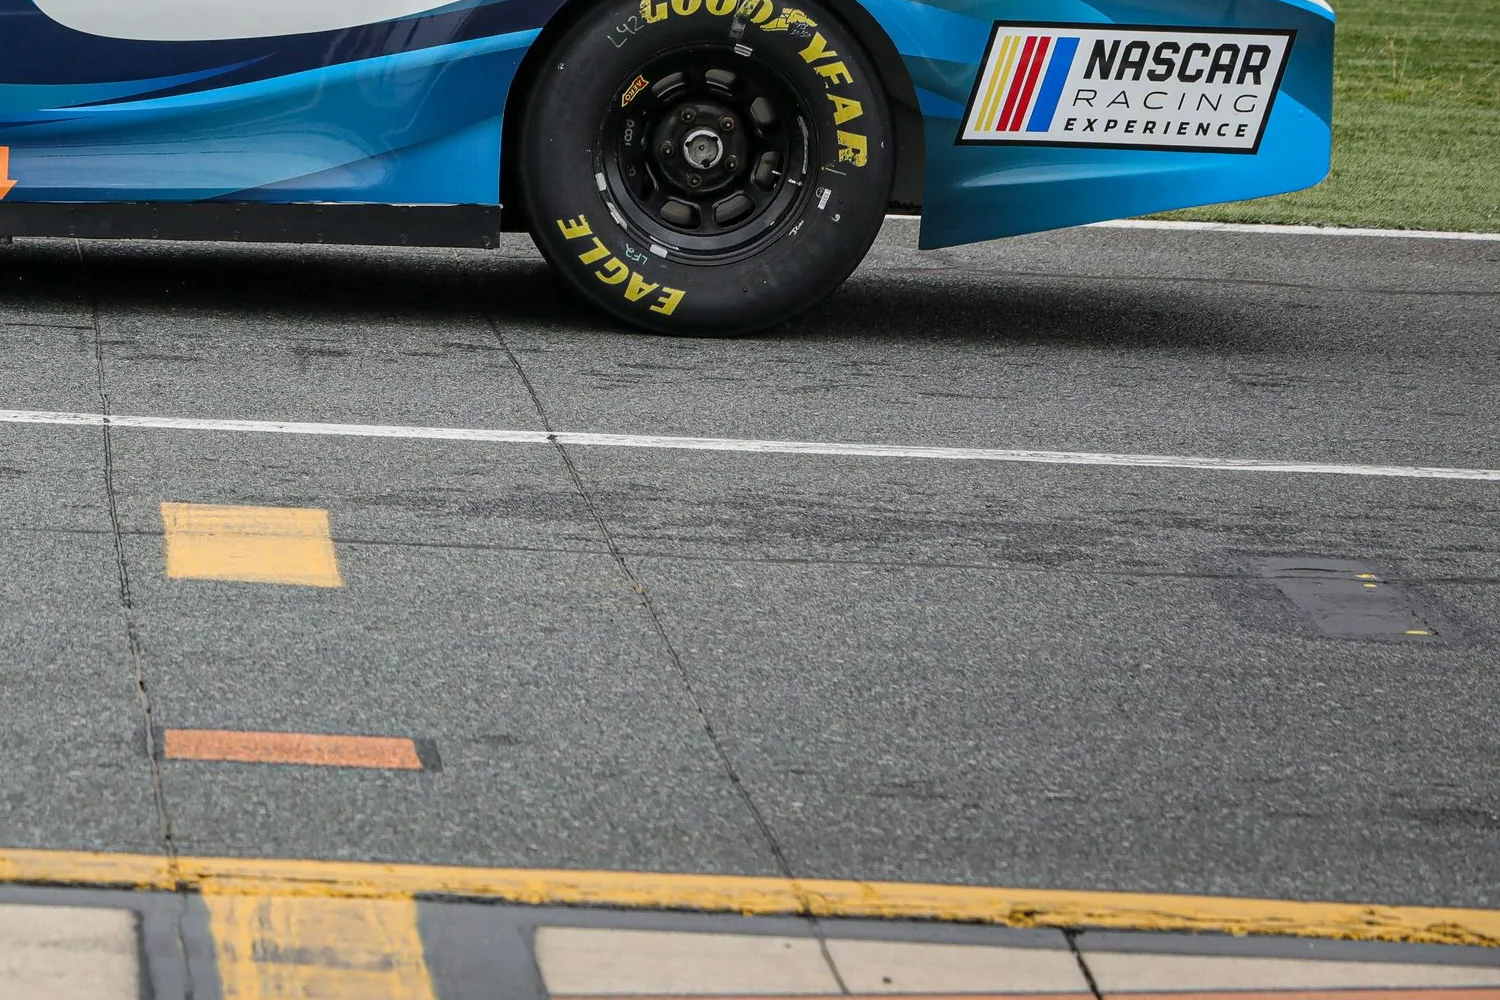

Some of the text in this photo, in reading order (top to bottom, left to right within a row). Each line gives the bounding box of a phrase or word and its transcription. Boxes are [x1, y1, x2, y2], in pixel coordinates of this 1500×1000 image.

[607, 15, 643, 48] L42
[1083, 39, 1272, 86] NASCAR
[625, 79, 643, 101] AERO
[1072, 89, 1258, 114] RACING
[1063, 117, 1249, 138] EXPERIENCE
[557, 215, 687, 317] EAGLE
